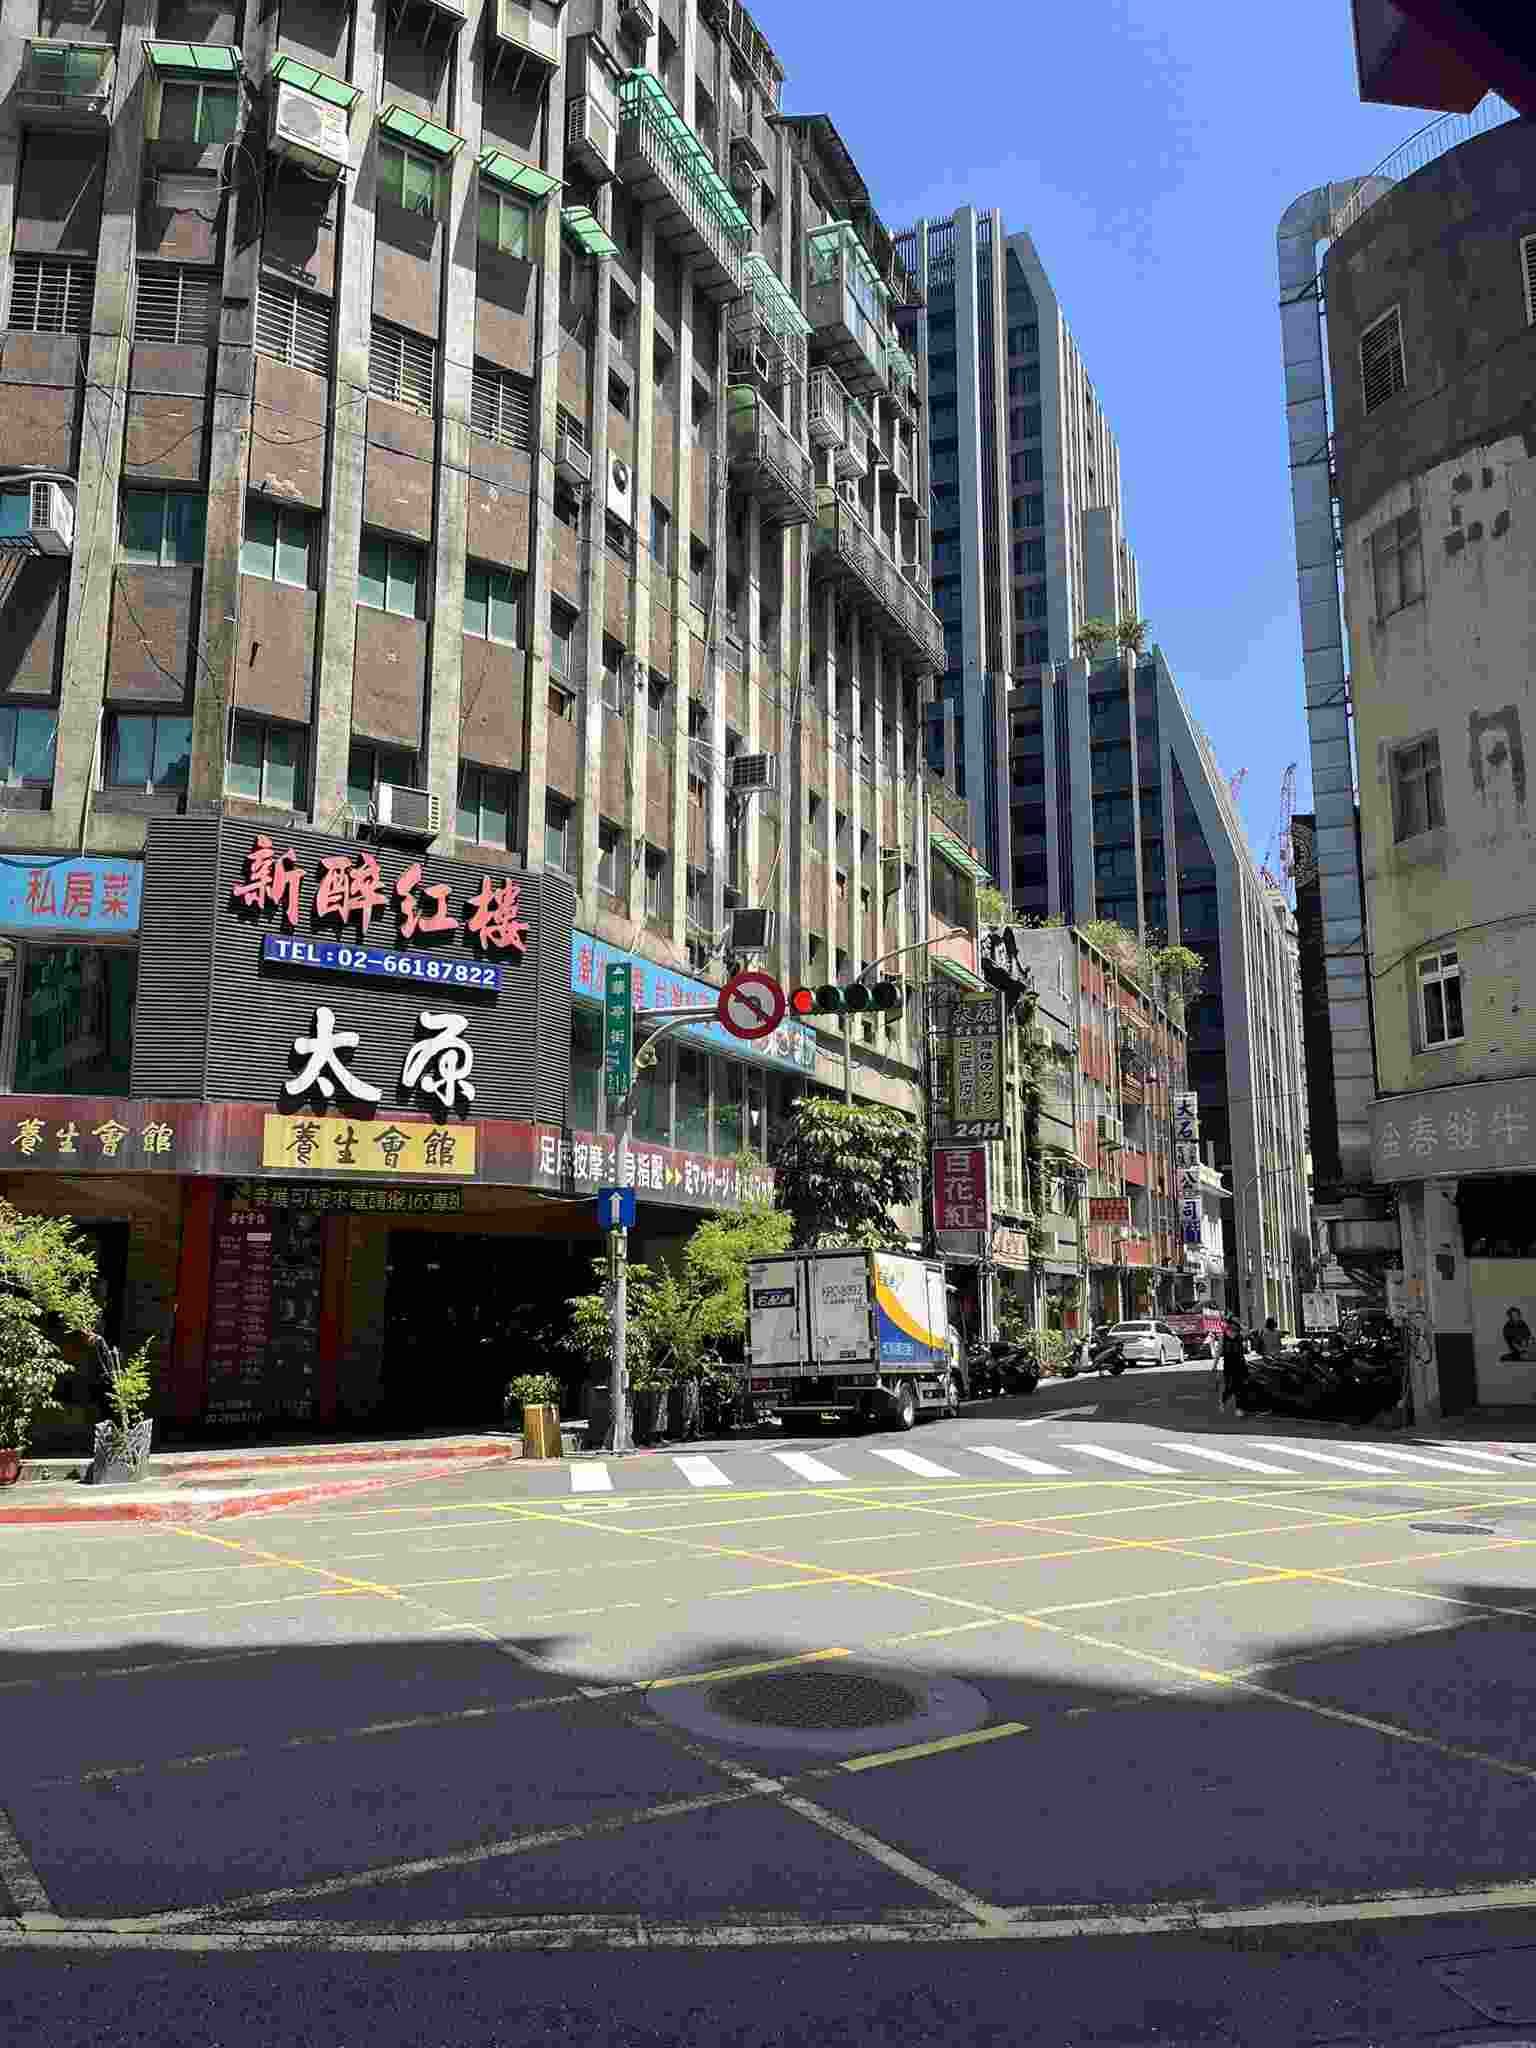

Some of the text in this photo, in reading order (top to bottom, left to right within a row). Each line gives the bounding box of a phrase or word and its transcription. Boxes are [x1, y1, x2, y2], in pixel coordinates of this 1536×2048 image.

[25, 869, 129, 919] 私房菜
[273, 938, 496, 986] TEL:02-66187822
[285, 1006, 476, 1106] 太原
[12, 1118, 175, 1157] 養生會館
[286, 1121, 457, 1168] 養生會館
[955, 1122, 1000, 1137] 24H
[944, 1152, 976, 1227] 百花紅
